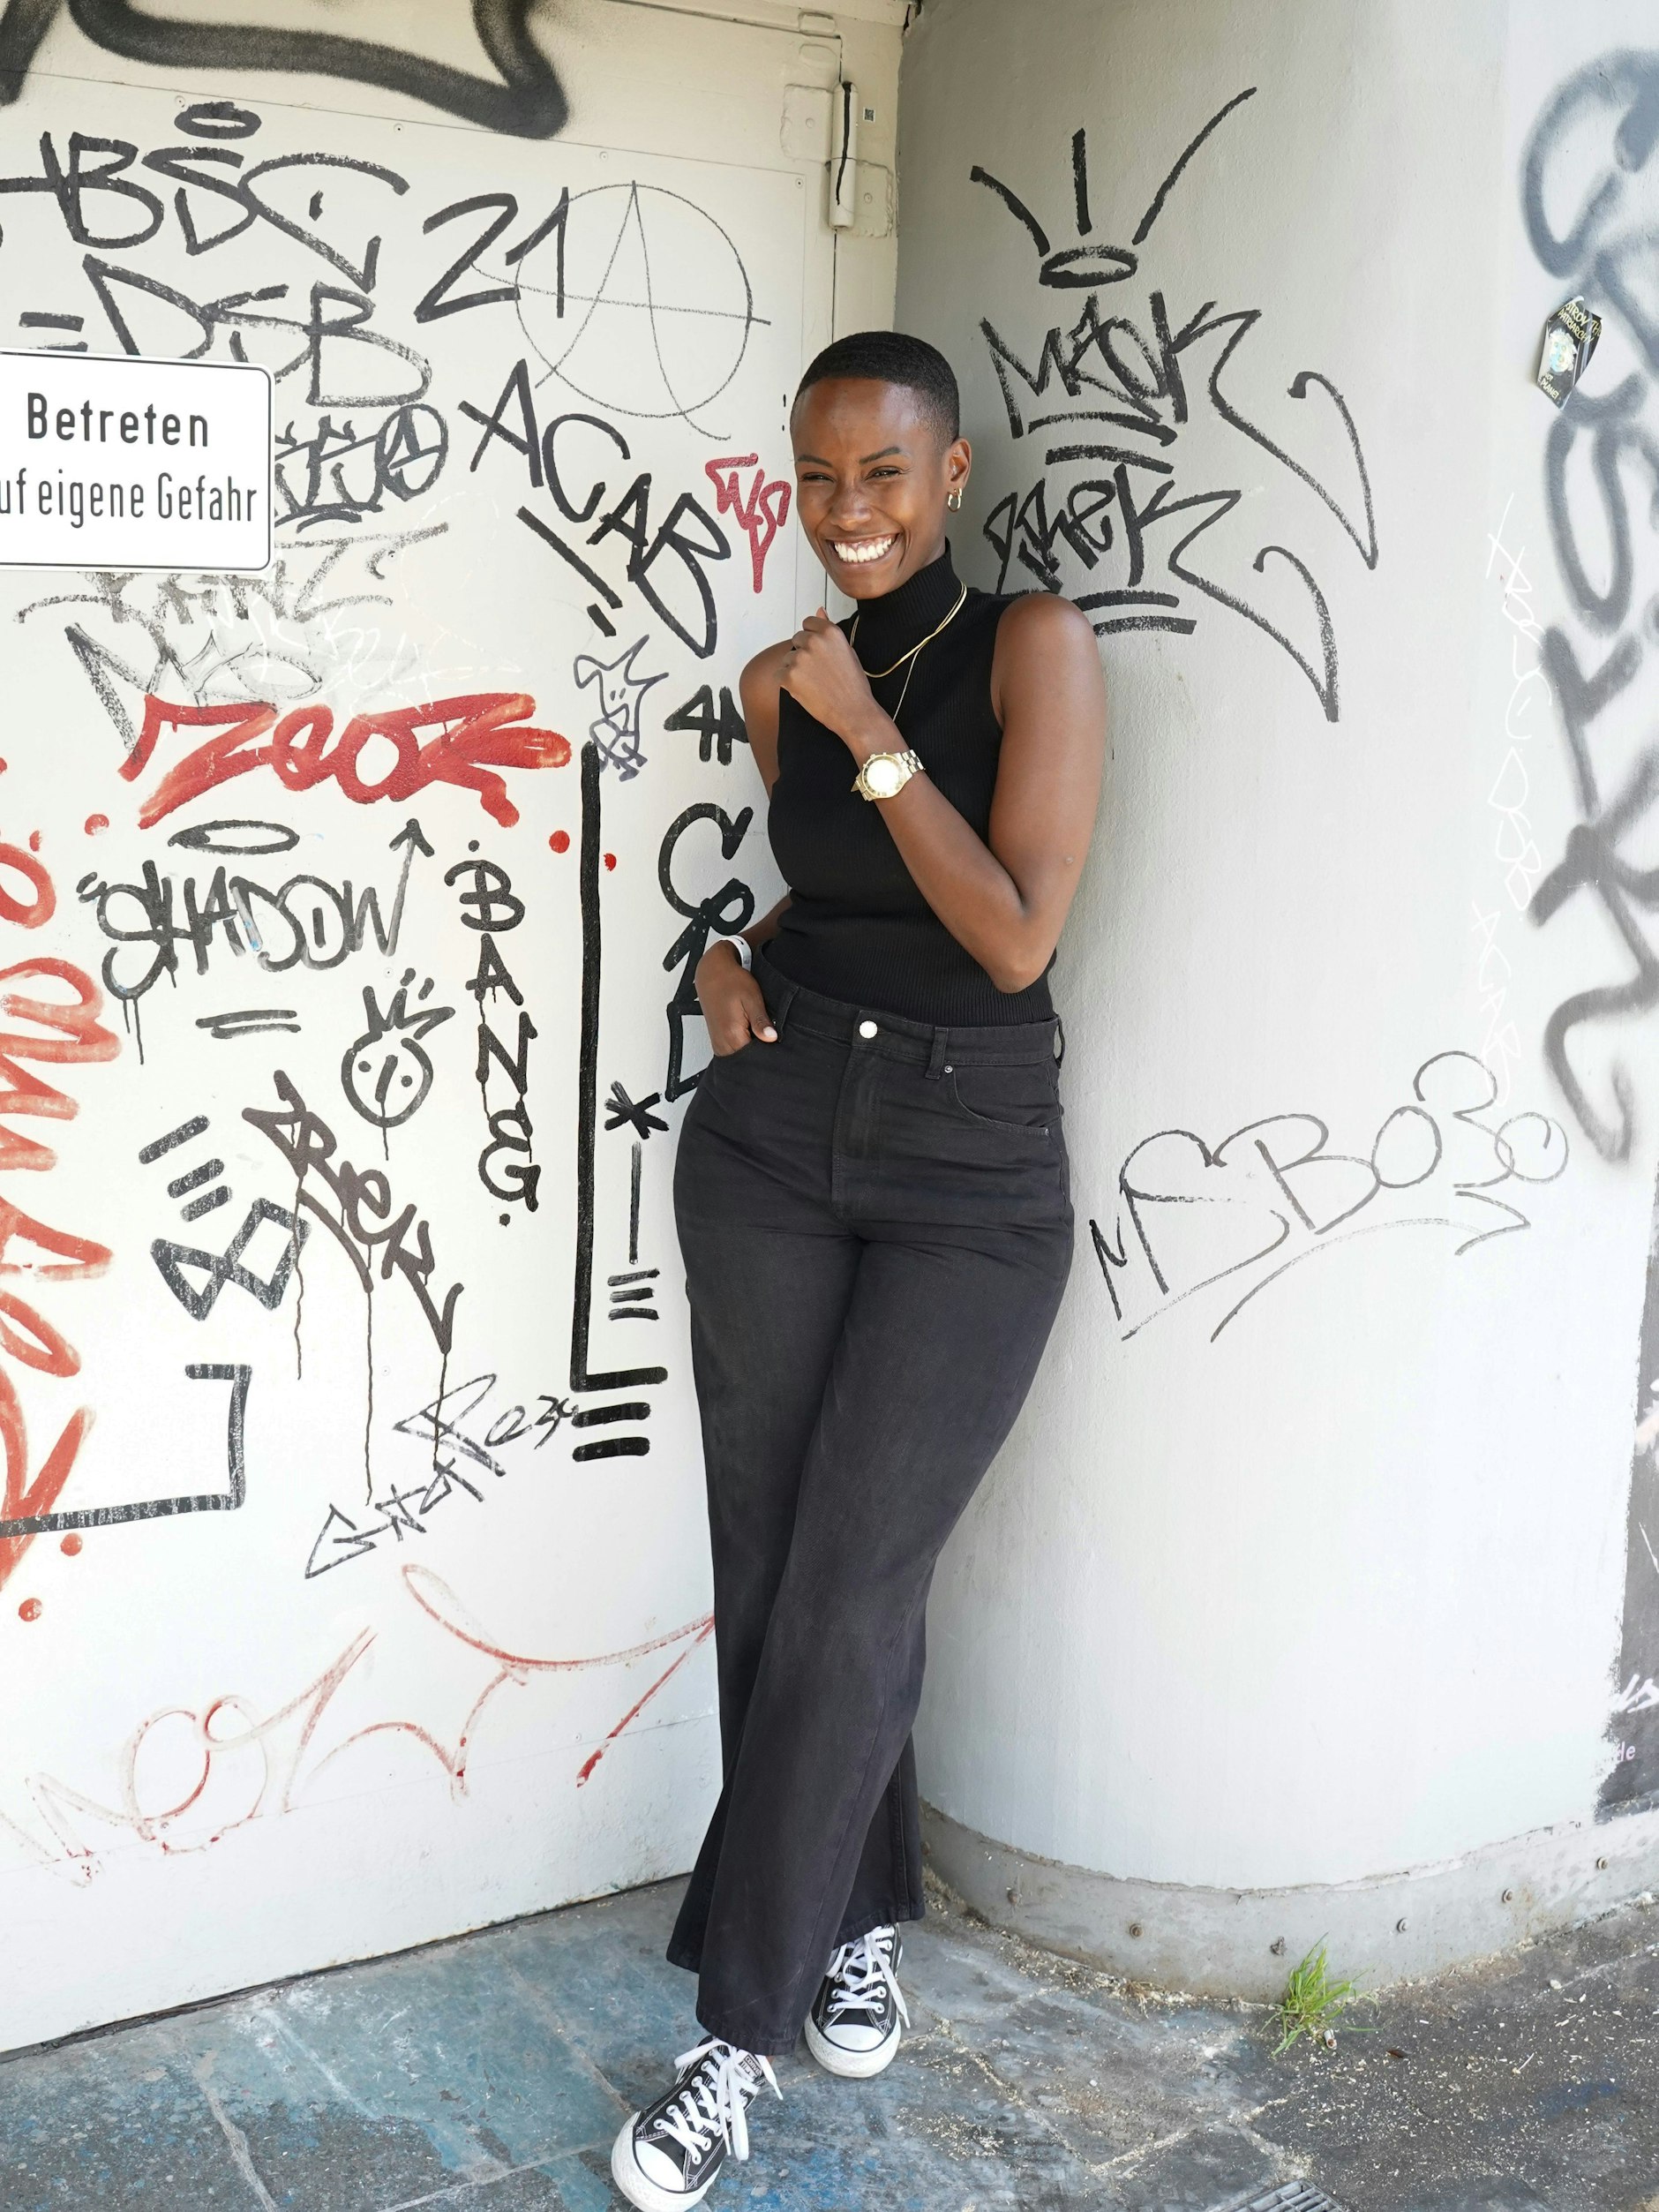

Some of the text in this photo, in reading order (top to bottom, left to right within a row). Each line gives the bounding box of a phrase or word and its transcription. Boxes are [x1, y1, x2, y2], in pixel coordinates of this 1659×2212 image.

[1558, 308, 1595, 345] PATRIARCHY
[1540, 378, 1560, 399] PLANET
[27, 392, 208, 448] Betreten
[38, 468, 145, 529] eigene
[158, 471, 257, 522] Gefahr
